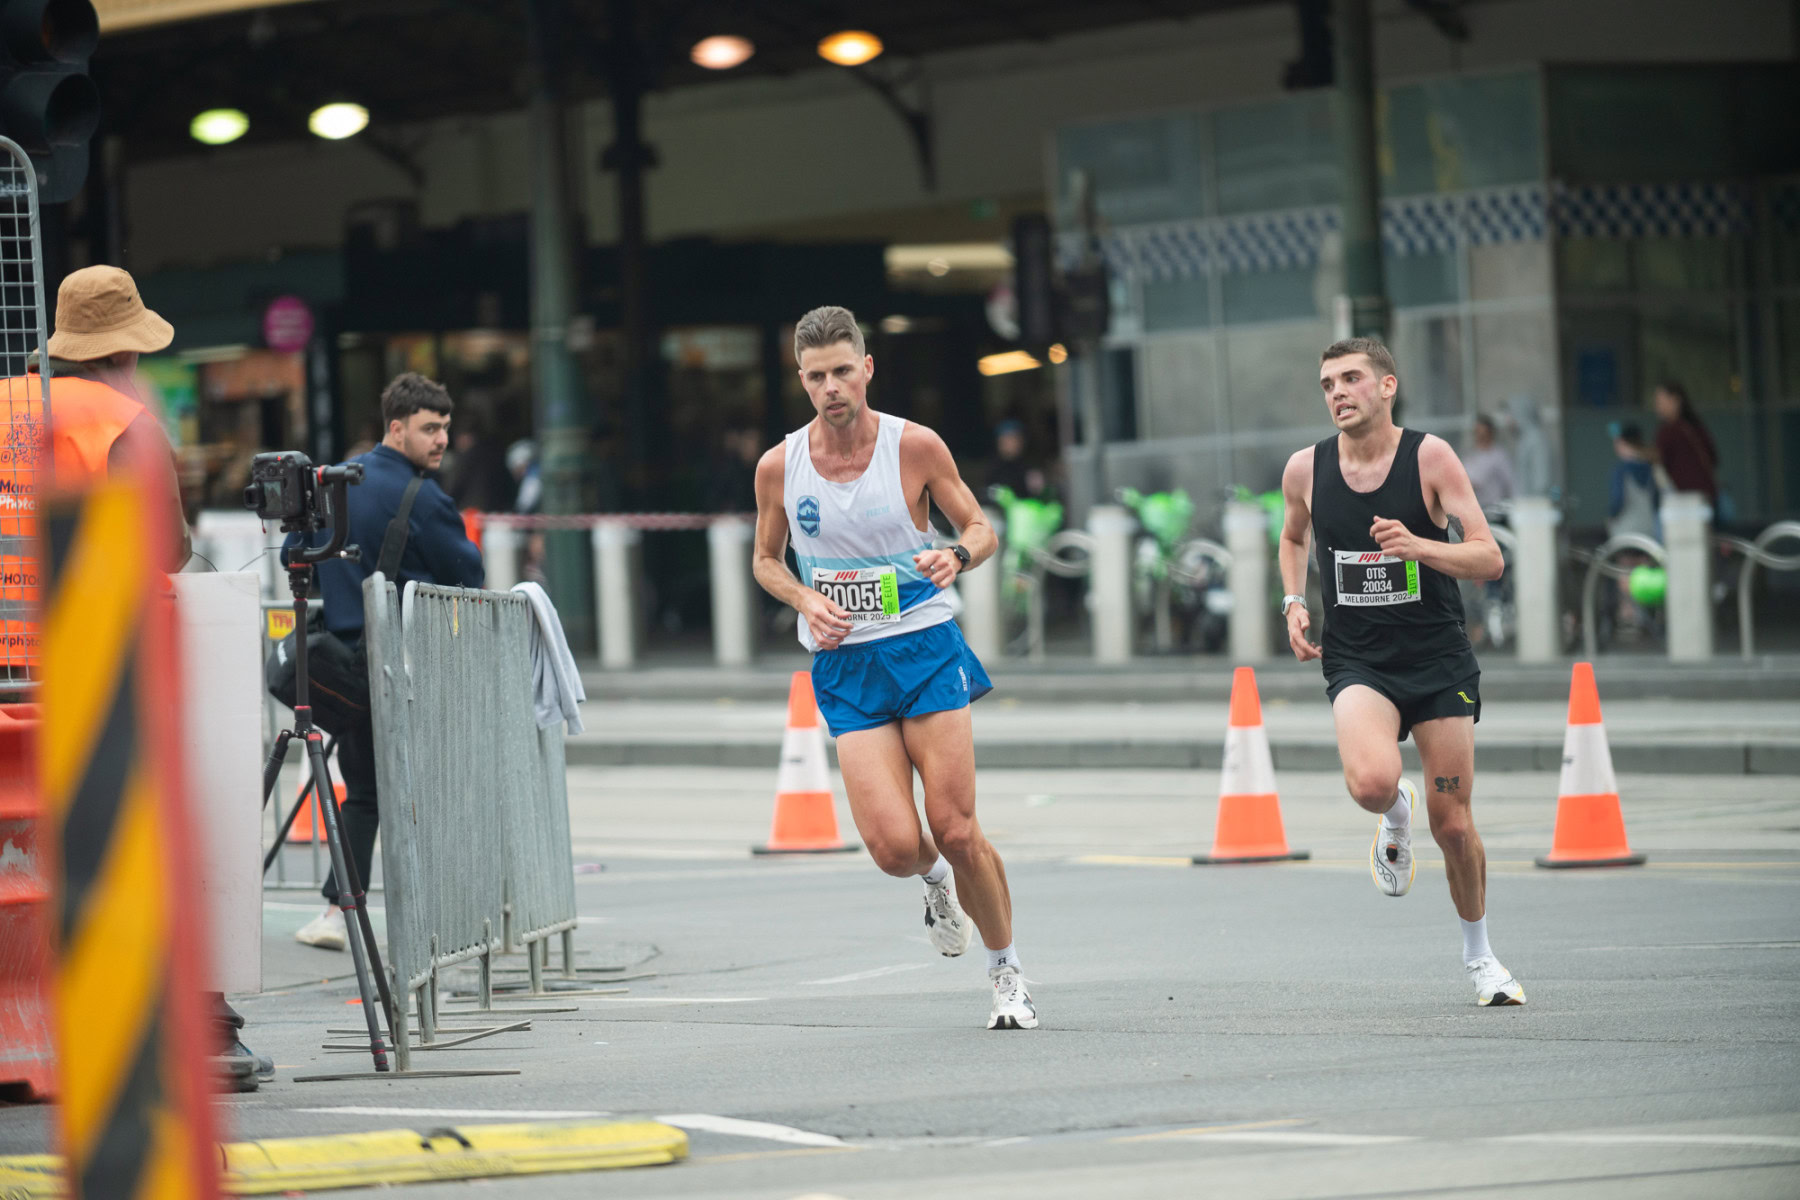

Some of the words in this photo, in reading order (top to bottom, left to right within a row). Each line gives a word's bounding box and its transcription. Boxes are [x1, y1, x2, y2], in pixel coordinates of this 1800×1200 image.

[1366, 567, 1387, 579] OTIS
[883, 575, 893, 598] ELITE
[1362, 580, 1393, 593] 20034
[1408, 573, 1418, 595] ELITE
[1344, 594, 1390, 604] MELBOURNE
